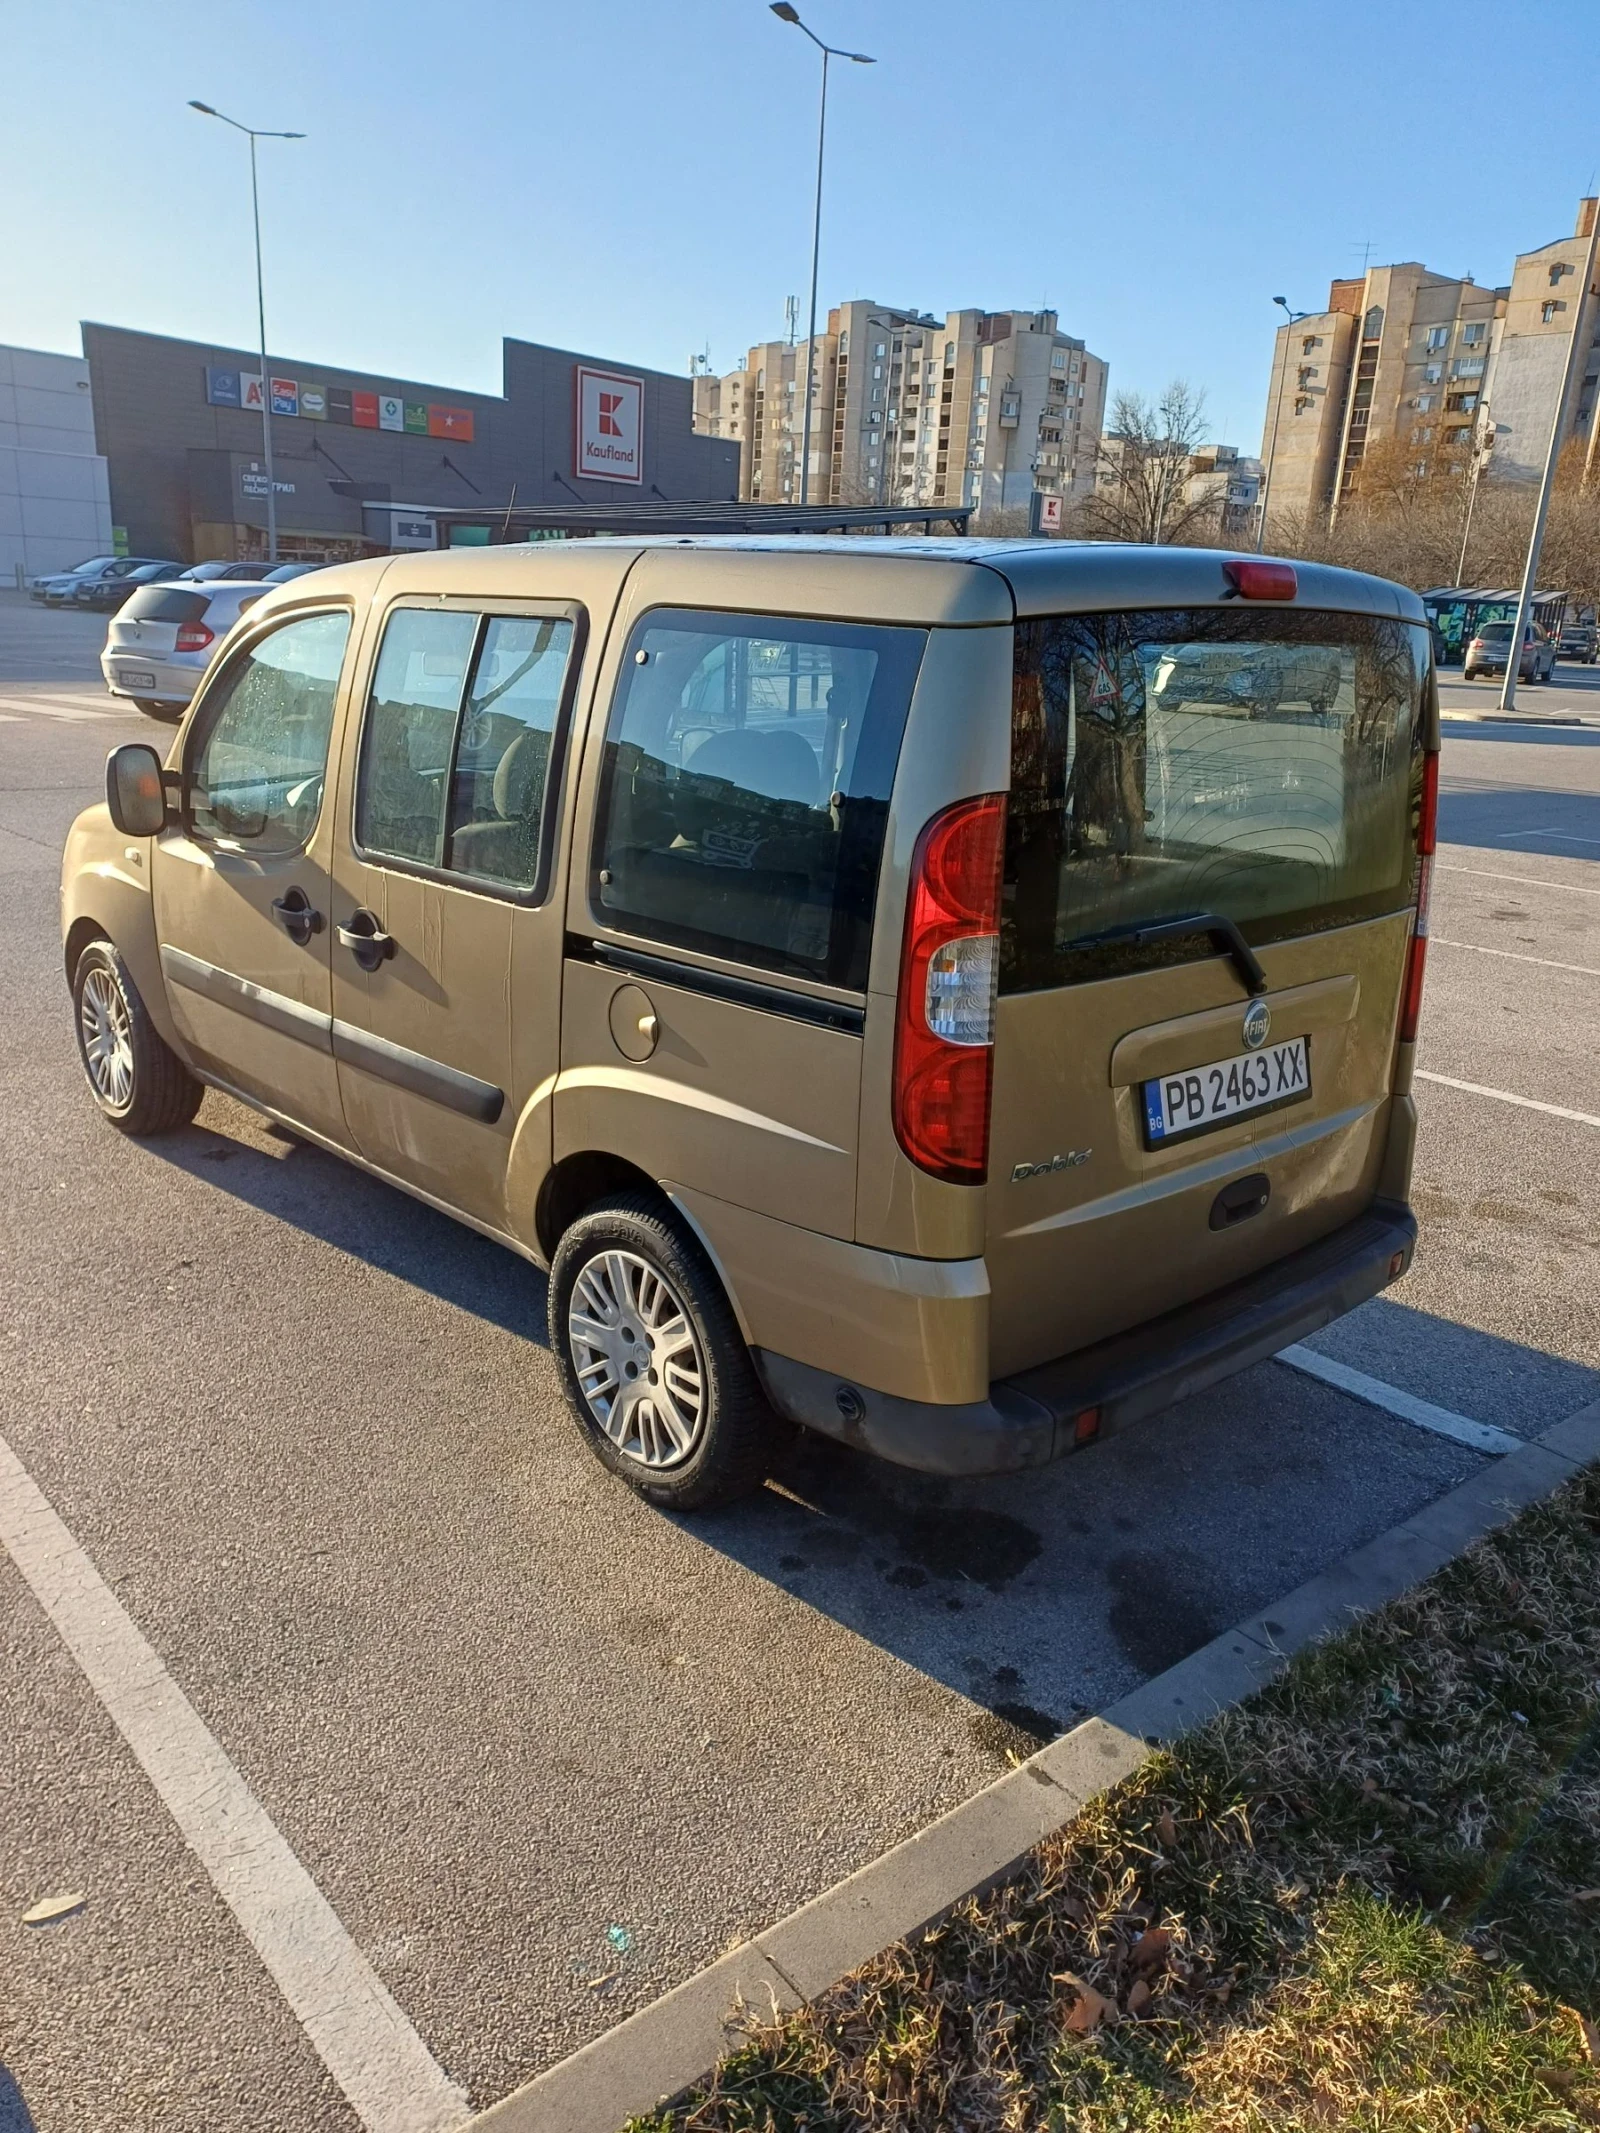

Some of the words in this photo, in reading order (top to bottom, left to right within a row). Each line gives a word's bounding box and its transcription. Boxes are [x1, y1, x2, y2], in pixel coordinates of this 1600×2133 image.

[273, 384, 296, 399] Easy
[275, 398, 292, 412] Pay
[586, 441, 634, 463] Kaufland
[272, 482, 296, 494] ГРИЛ
[1098, 682, 1111, 695] GAS
[1249, 1018, 1268, 1036] FIAT
[1166, 1075, 1205, 1127] PB
[1209, 1056, 1270, 1114] 2463
[1273, 1044, 1304, 1093] XX
[1149, 1116, 1163, 1131] BG
